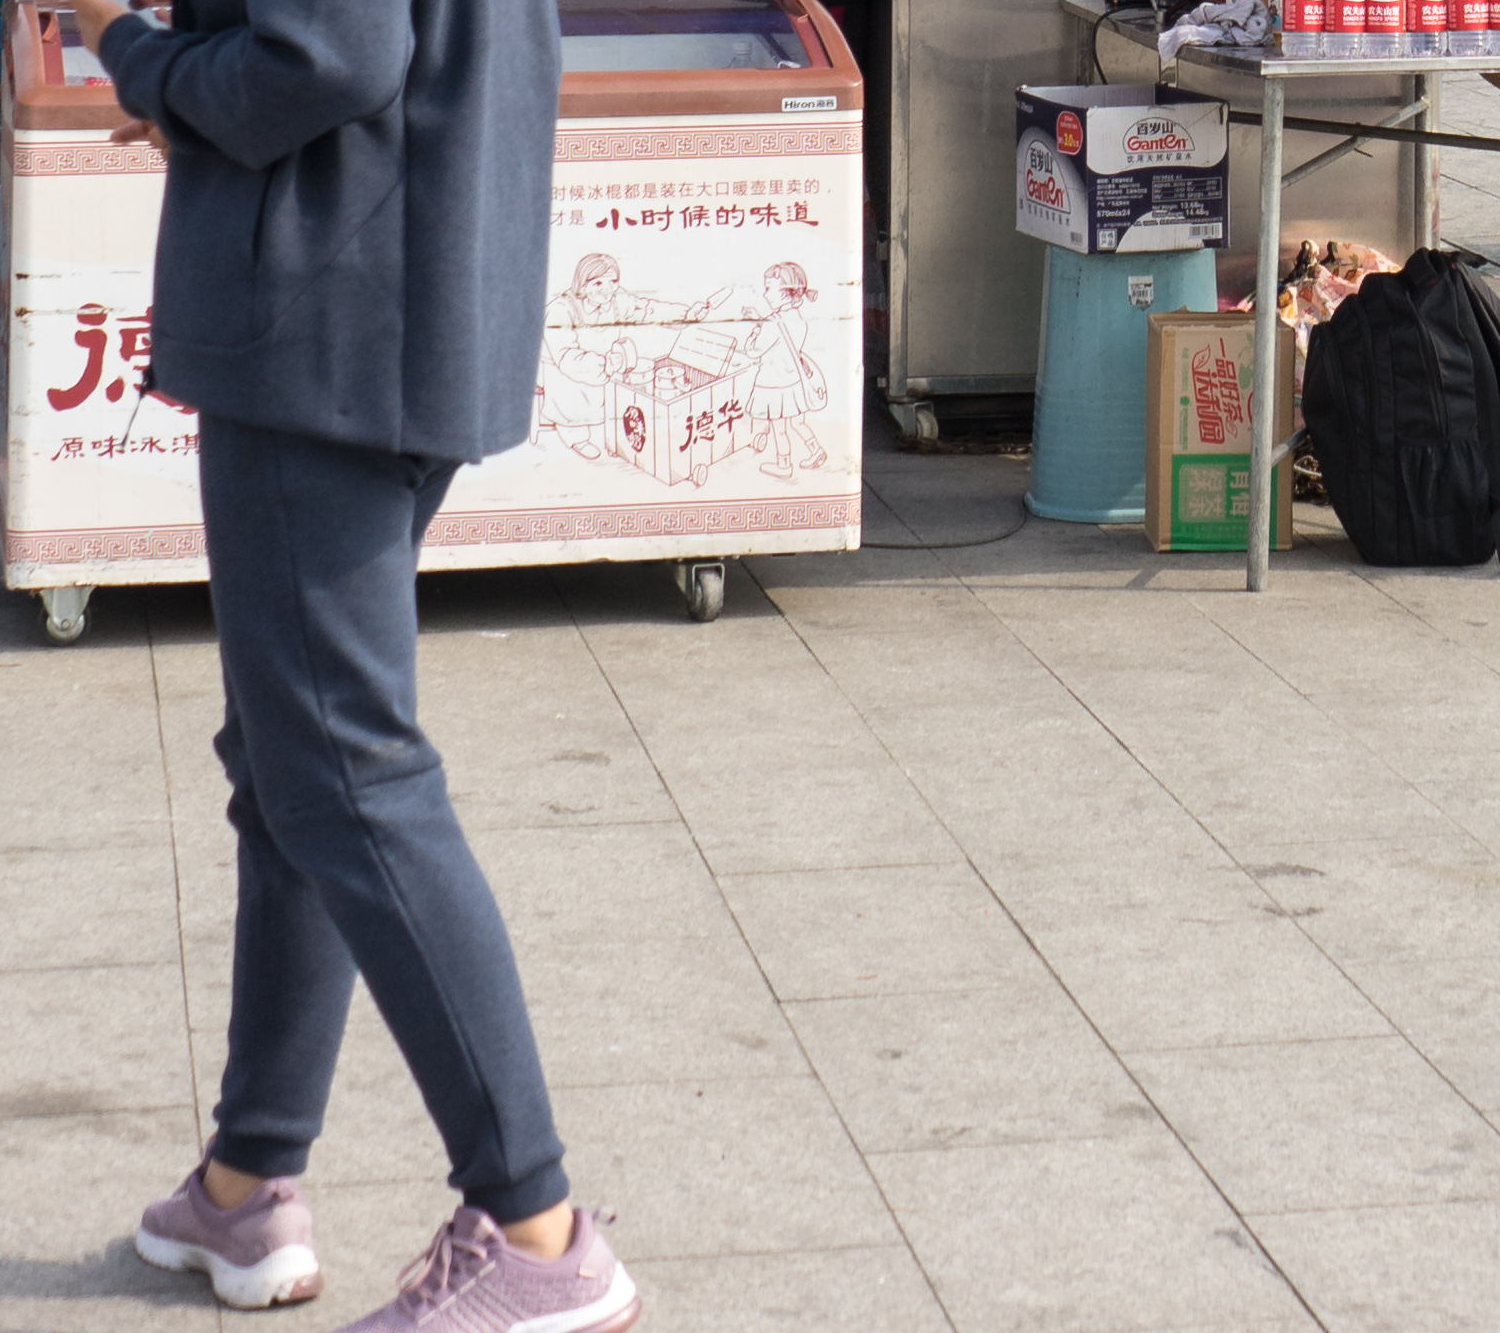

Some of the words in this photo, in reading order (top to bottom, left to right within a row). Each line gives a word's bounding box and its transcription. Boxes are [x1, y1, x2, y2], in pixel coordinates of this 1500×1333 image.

[1126, 134, 1188, 151] Ganten
[1136, 121, 1176, 136] 百岁山
[1029, 147, 1054, 176] 百岁山
[551, 209, 585, 227] 才是
[595, 200, 819, 232] 小时候的味道
[1214, 337, 1244, 424] 一品好茶
[1191, 363, 1226, 445] 达利园
[679, 398, 745, 453] 德华
[51, 434, 200, 462] 原味冰淇
